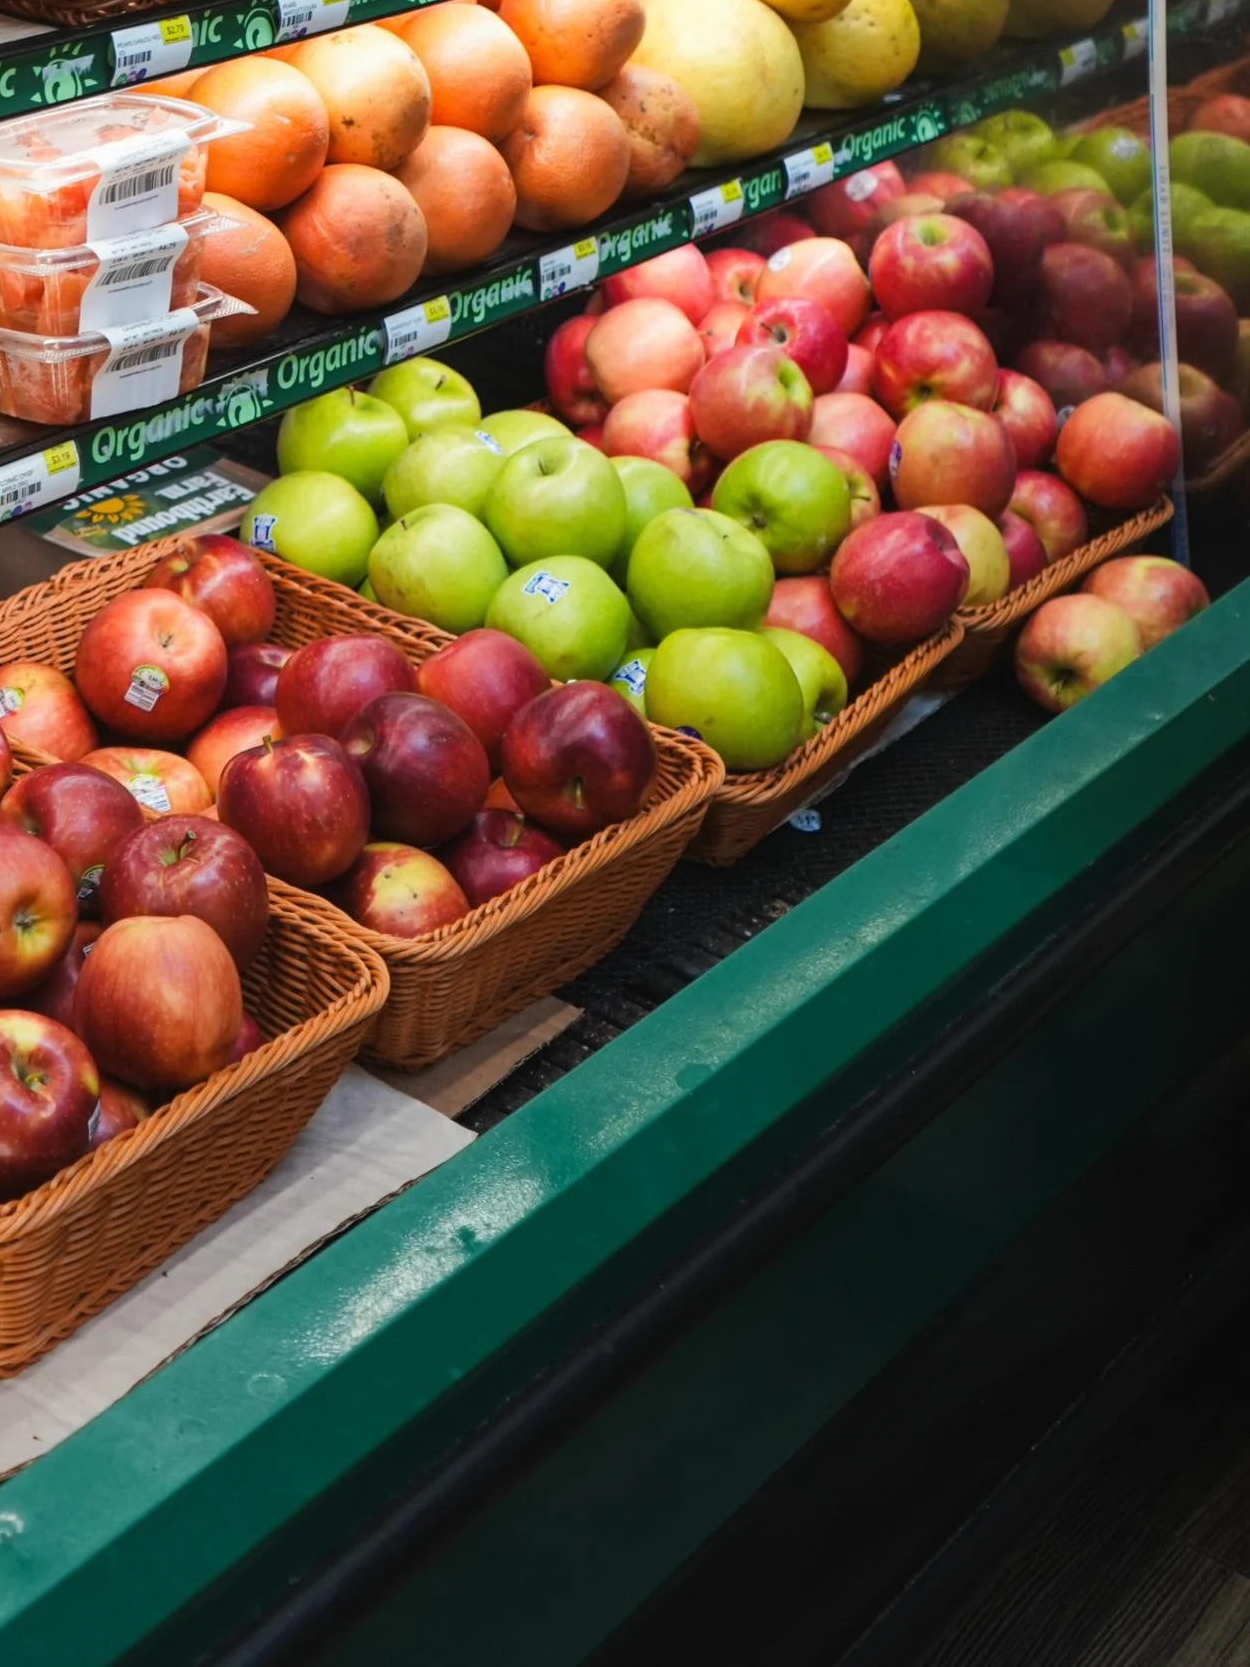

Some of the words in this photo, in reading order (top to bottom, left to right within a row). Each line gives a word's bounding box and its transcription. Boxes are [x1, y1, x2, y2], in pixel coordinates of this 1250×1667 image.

[166, 23, 185, 36] $2.79
[842, 114, 906, 162] Organic
[743, 169, 781, 208] rgan
[599, 212, 673, 264] Organic
[448, 266, 533, 324] Organic
[277, 328, 380, 391] Organic
[92, 395, 206, 466] Organic
[52, 452, 70, 466] $3.19
[155, 471, 232, 500] Farm
[111, 483, 256, 546] Earthbound
